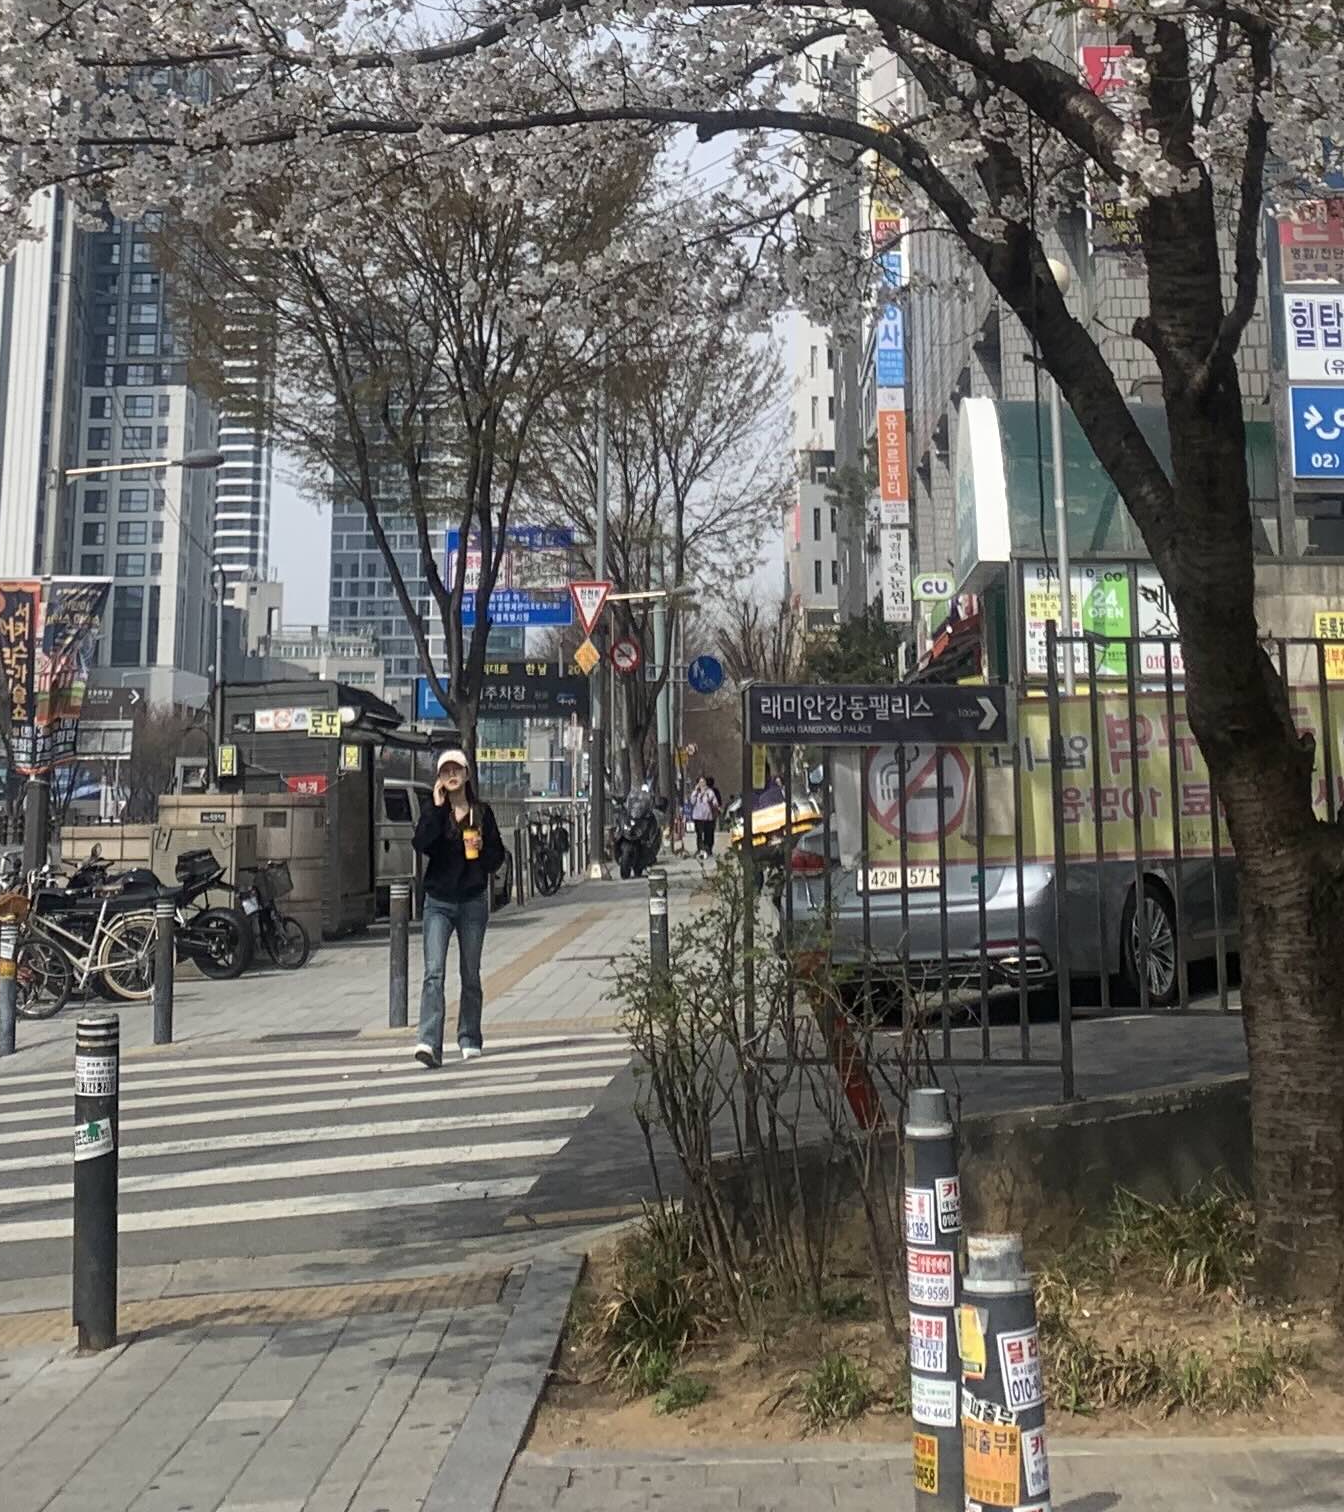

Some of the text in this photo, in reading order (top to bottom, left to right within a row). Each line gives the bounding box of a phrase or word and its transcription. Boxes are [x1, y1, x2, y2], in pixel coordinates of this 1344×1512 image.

[1311, 454, 1340, 470] 02)
[922, 581, 948, 595] CU
[1092, 588, 1118, 606] 24
[1088, 607, 1124, 619] OPEN
[760, 693, 934, 721] 래미안강동팰리스
